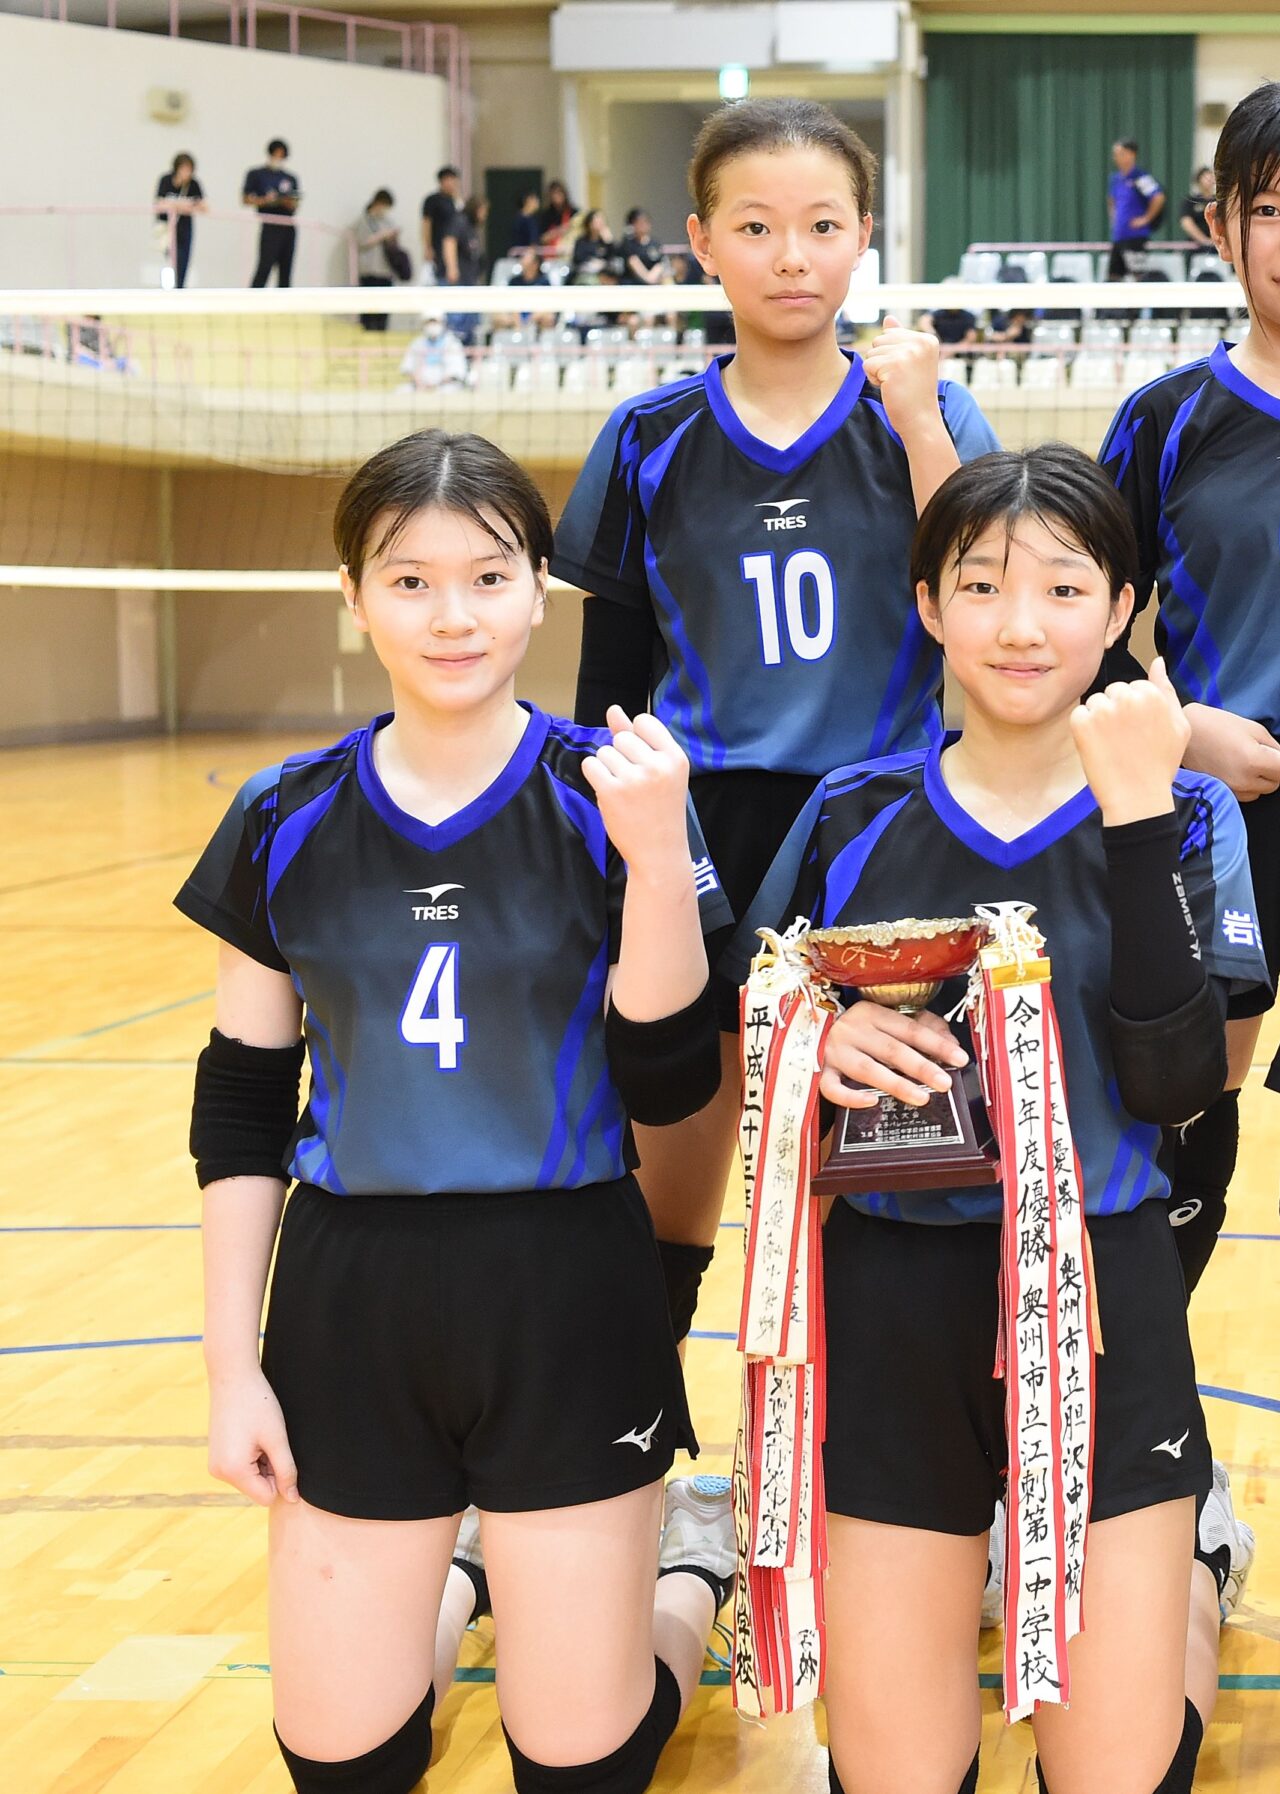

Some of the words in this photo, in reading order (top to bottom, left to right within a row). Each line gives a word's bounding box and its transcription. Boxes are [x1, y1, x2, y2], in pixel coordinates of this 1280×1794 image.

[763, 515, 808, 531] TRES
[741, 549, 836, 667] 10
[411, 904, 460, 921] TRES
[1221, 908, 1262, 950] 岩
[400, 944, 466, 1071] 4
[741, 1006, 774, 1252] 平成二十三
[1004, 995, 1055, 1269] 令和七年度優勝
[1017, 1283, 1064, 1691] 奥州市立江刺第一中学校
